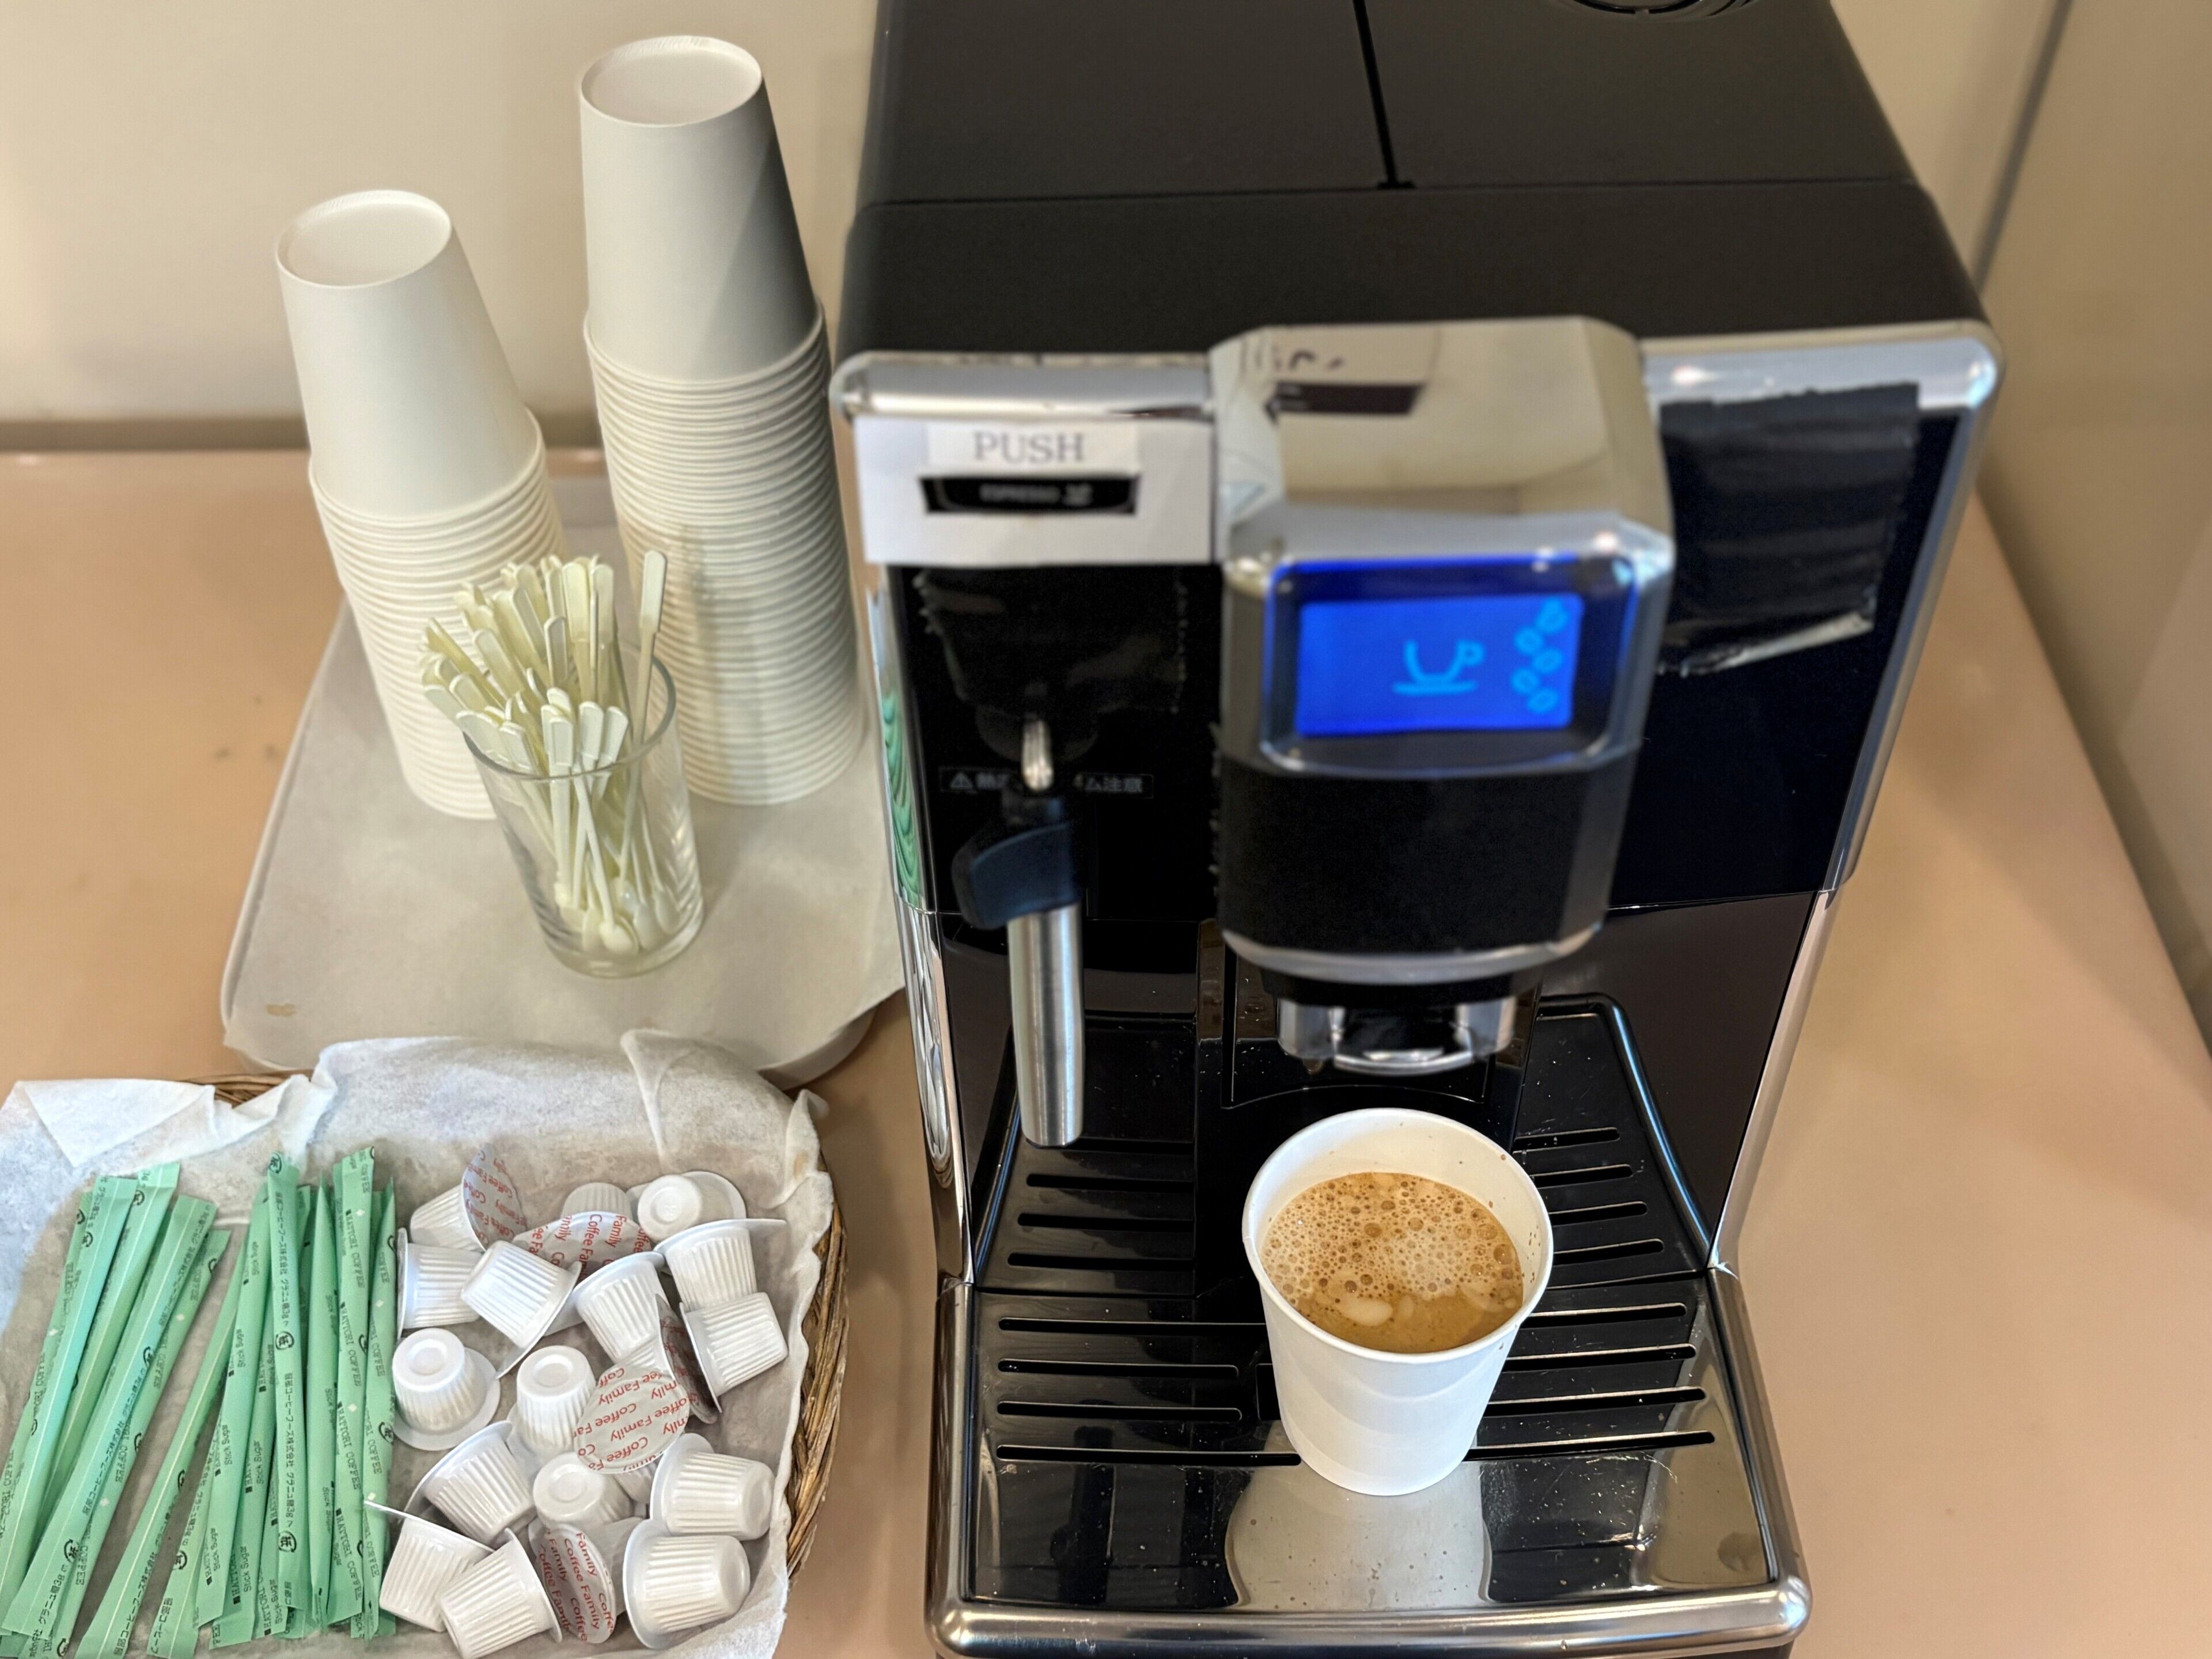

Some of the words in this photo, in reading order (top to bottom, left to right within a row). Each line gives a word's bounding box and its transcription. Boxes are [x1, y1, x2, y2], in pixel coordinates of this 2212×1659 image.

[974, 431, 1086, 463] PUSH
[584, 1214, 603, 1246] Coffee
[605, 1215, 627, 1248] Family
[599, 1380, 640, 1405] Family
[654, 1397, 688, 1418] offee
[595, 1403, 637, 1427] Coffee
[611, 1415, 653, 1442] Family
[224, 1447, 233, 1465] Stick
[368, 1440, 382, 1474] COFFEE
[607, 1437, 649, 1462] Coffee
[346, 1451, 361, 1490] COFFEE
[240, 1546, 249, 1570] Sugar
[549, 1539, 567, 1581] Family
[576, 1532, 597, 1577] Family
[243, 1571, 252, 1593] Stick
[565, 1538, 584, 1582] Coffee
[581, 1585, 600, 1630] Family
[571, 1598, 588, 1642] Coffee
